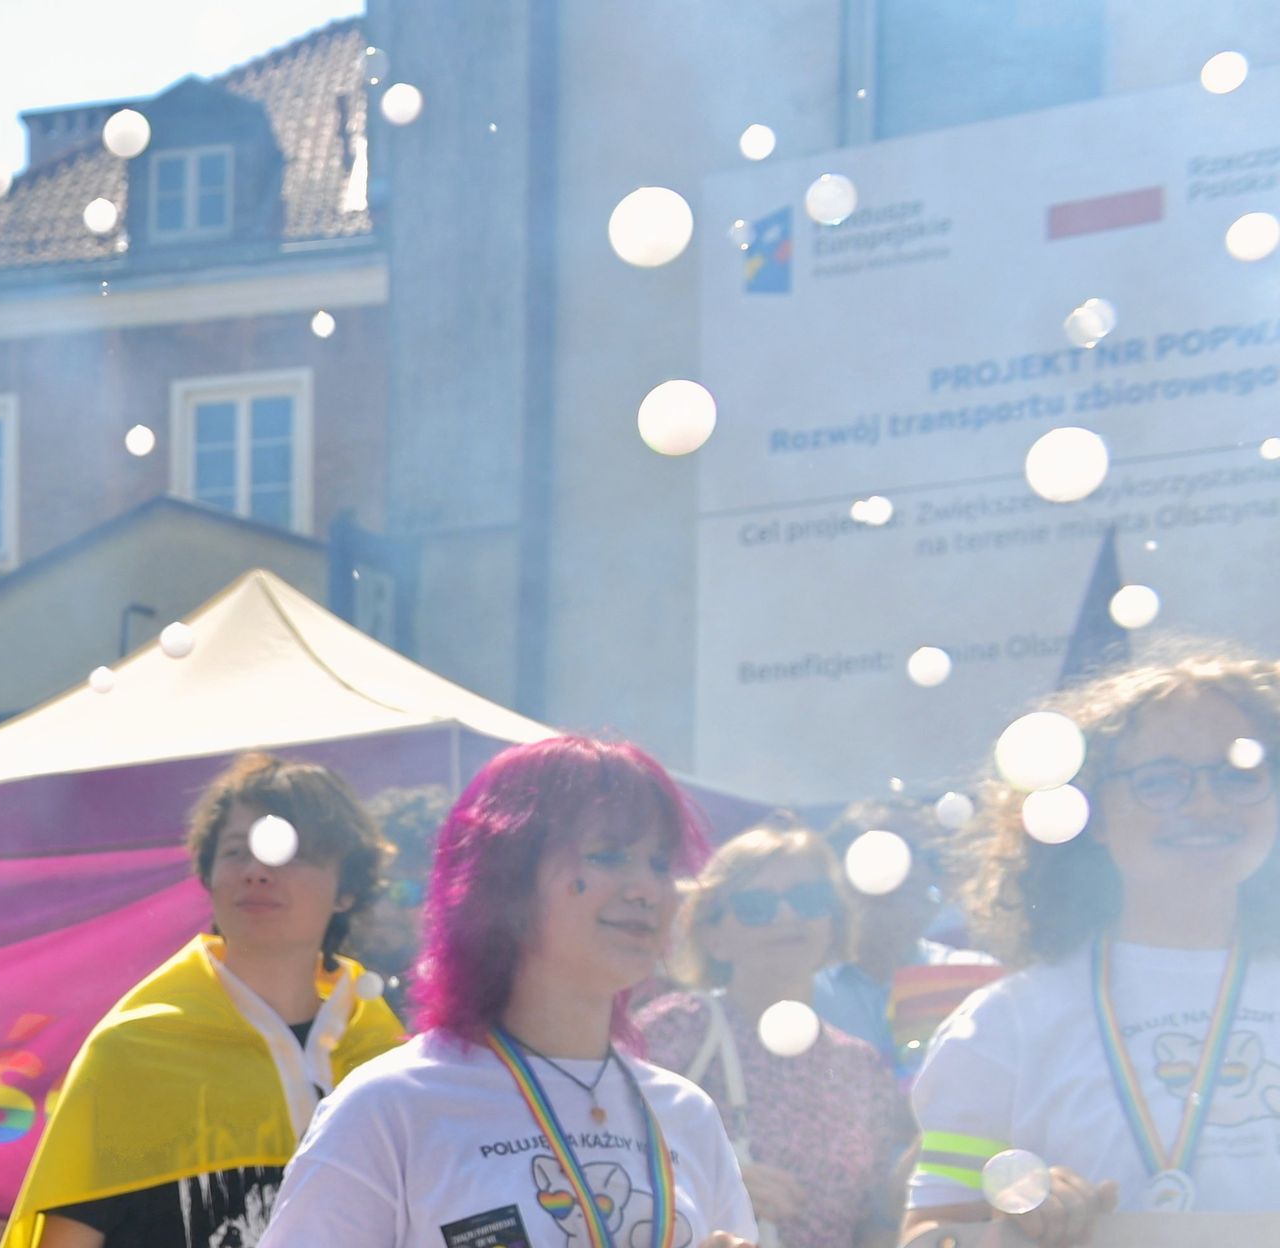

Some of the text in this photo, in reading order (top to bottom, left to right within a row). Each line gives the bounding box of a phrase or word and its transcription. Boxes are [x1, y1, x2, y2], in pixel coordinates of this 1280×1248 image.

[930, 346, 1086, 392] PROJEKT
[1096, 337, 1148, 367] NR
[767, 364, 1278, 455] Rozwój transportu zbiorowego
[739, 519, 781, 547] Cel
[914, 534, 948, 556] na
[953, 524, 1049, 552] terenie
[1056, 511, 1151, 541] miasta
[738, 650, 893, 686] Beneficjent:
[580, 1131, 633, 1150] KAŻDY
